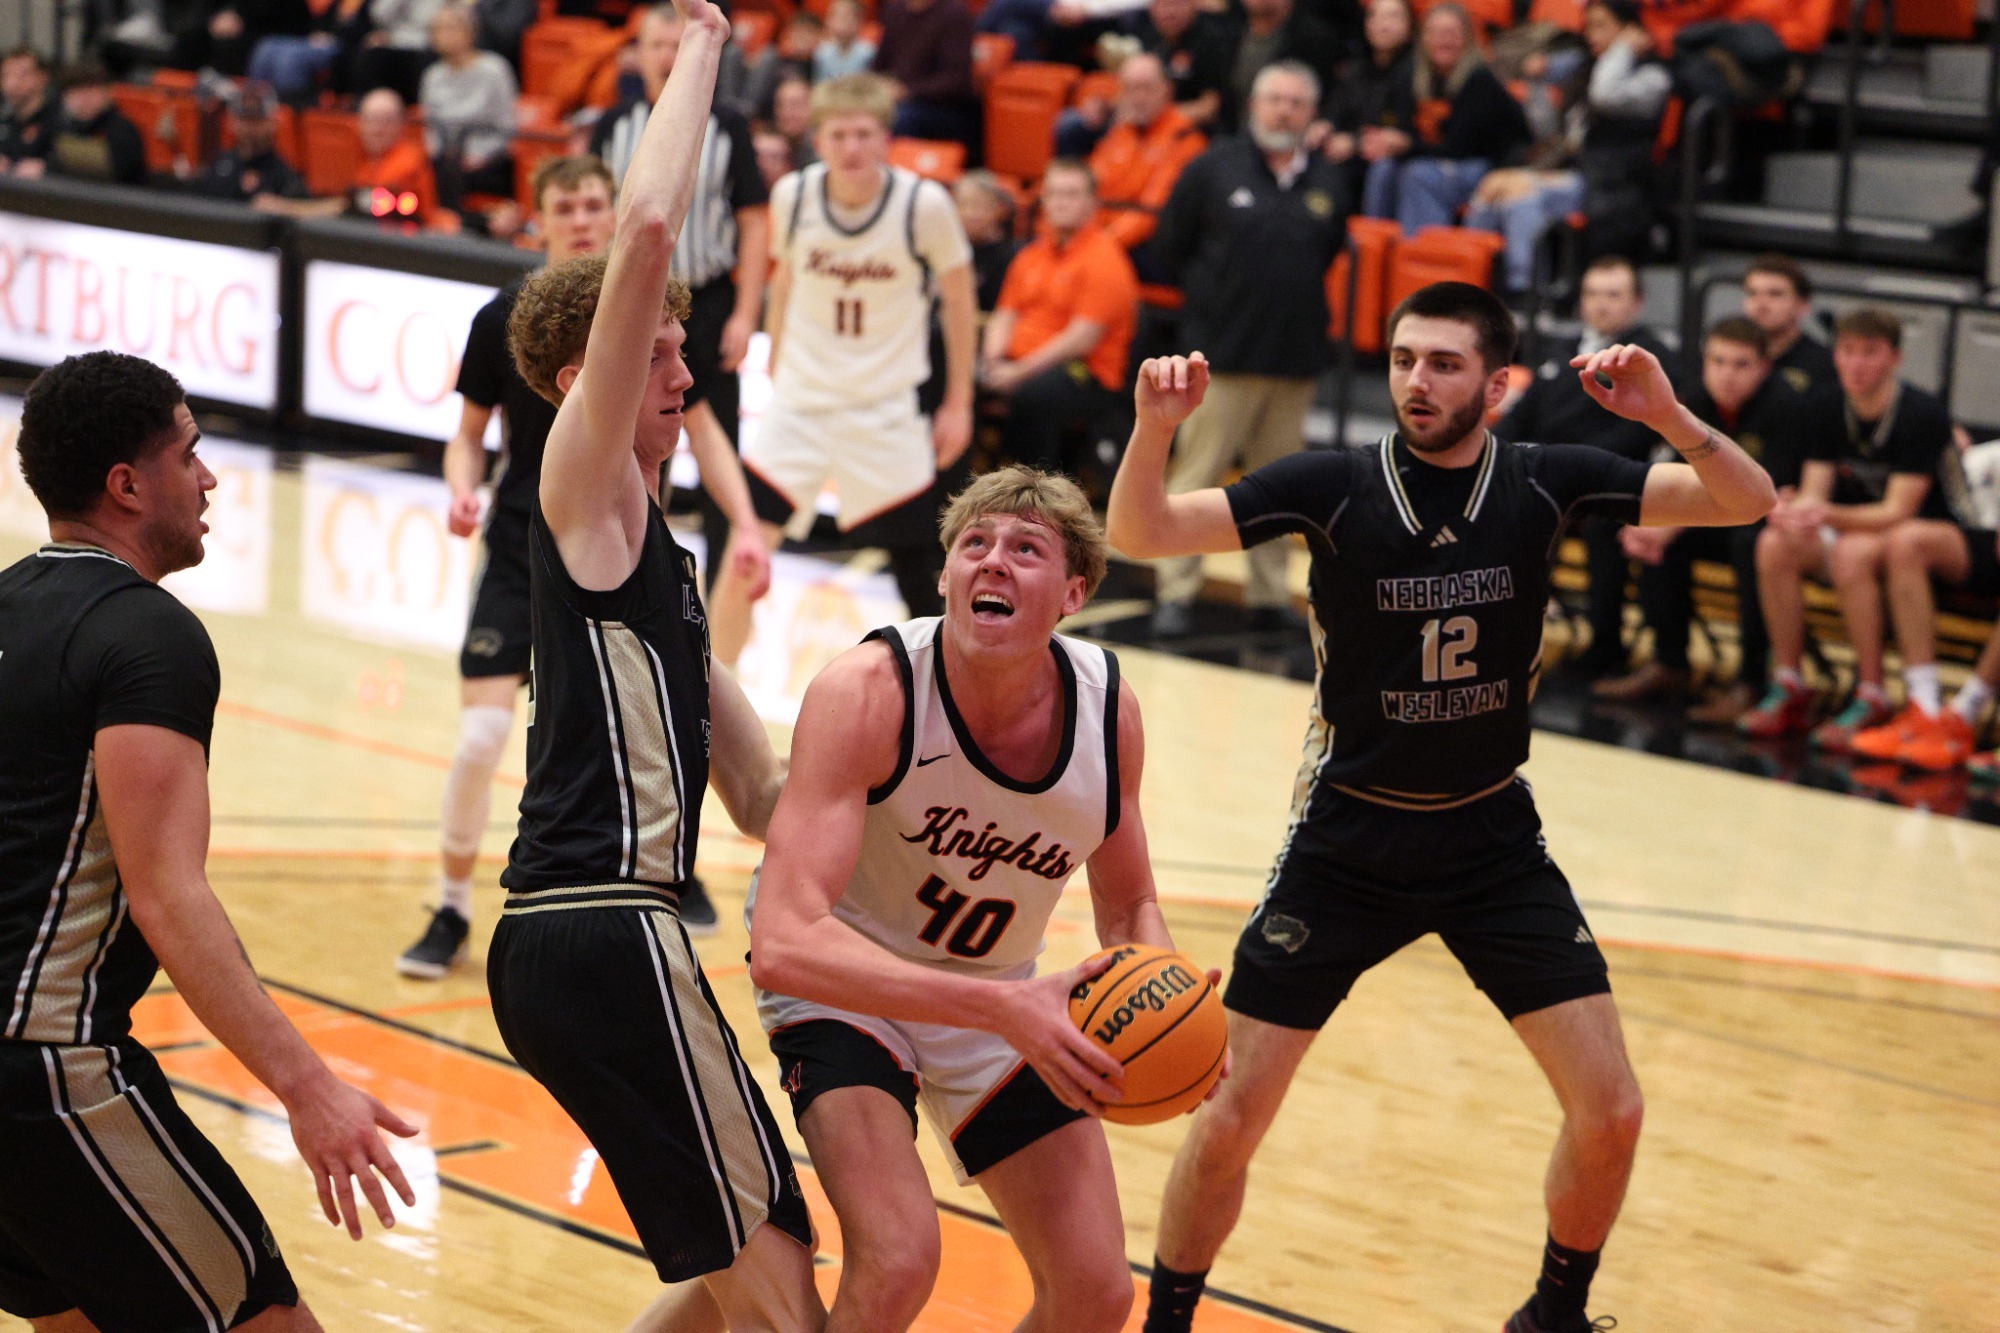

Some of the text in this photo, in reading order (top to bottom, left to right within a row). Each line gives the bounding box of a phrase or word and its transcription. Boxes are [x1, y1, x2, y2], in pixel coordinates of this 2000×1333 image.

[323, 299, 463, 407] CO
[834, 298, 863, 337] 11
[1377, 566, 1514, 611] NEBRASKA
[1420, 615, 1478, 682] 12
[1381, 678, 1509, 723] WESLEYAN
[898, 806, 1074, 881] Knights
[915, 872, 1017, 958] 40
[1093, 964, 1197, 1045] Wilson
